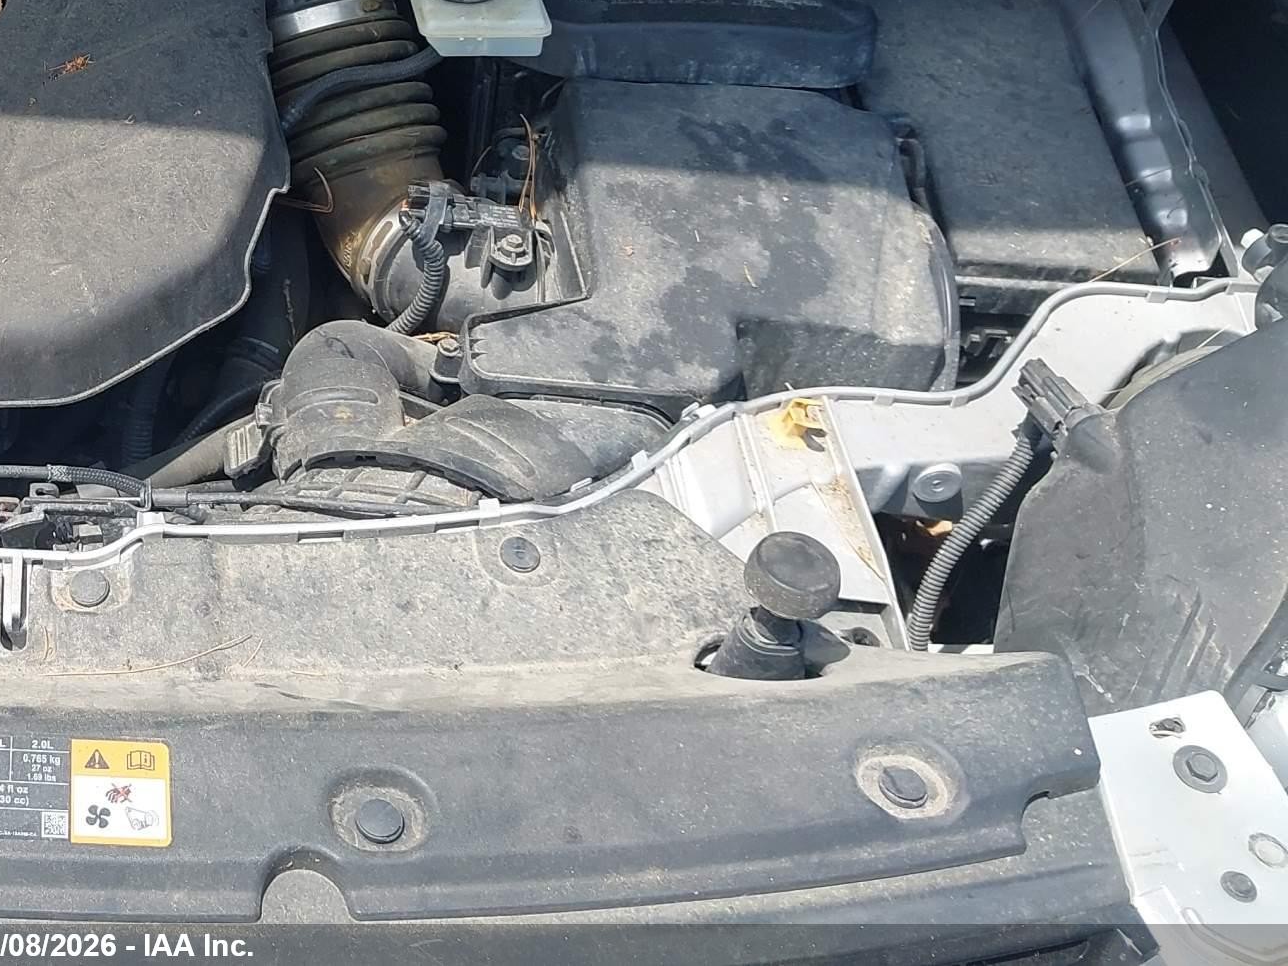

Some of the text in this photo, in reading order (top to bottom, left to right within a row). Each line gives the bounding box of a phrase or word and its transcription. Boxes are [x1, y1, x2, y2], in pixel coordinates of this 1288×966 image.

[32, 740, 54, 750] 2.0L
[23, 754, 60, 765] 0.765 kg
[44, 774, 56, 782] lbs
[7, 784, 14, 793] fl
[14, 795, 29, 806] cc)
